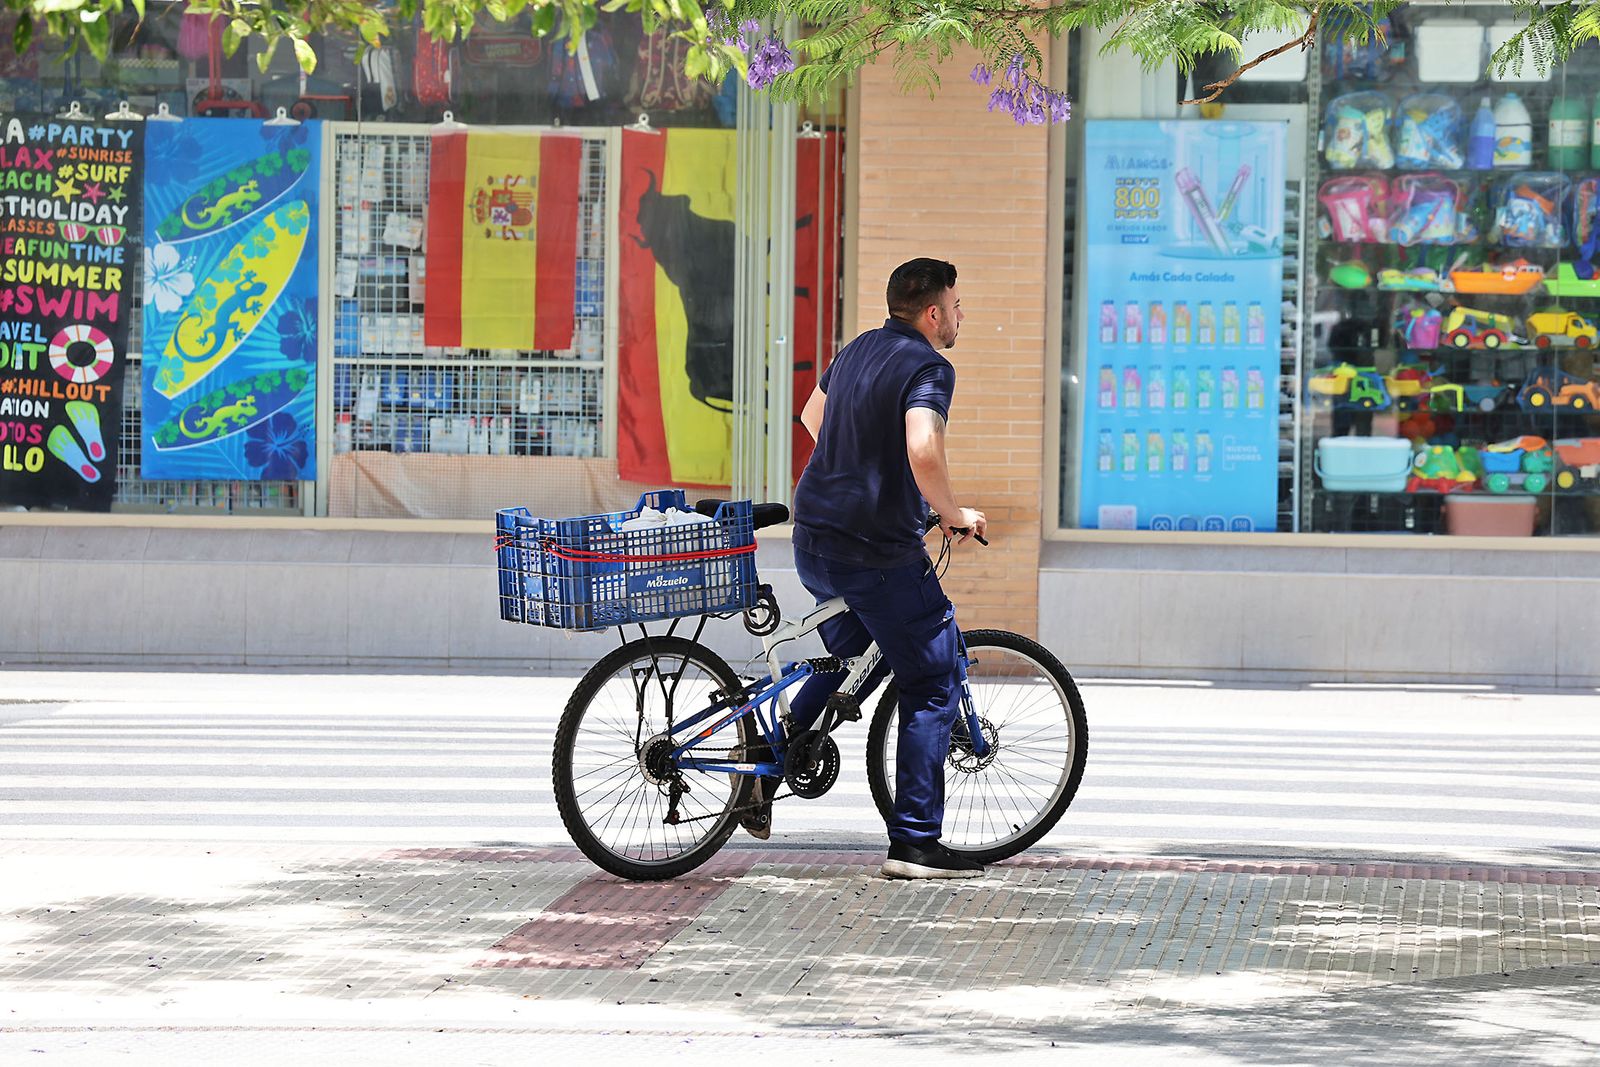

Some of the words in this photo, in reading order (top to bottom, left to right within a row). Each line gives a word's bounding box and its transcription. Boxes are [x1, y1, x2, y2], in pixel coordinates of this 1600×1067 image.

[28, 124, 134, 148] #PARTY
[56, 147, 133, 163] #SUNRISE
[58, 163, 132, 184] #SURF
[1114, 186, 1160, 210] 800
[0, 237, 125, 264] EAFUNTIME
[0, 258, 123, 292] SUMMER
[1162, 271, 1193, 283] Cada
[1194, 271, 1235, 283] Calada
[646, 576, 689, 588] Mozuelo
